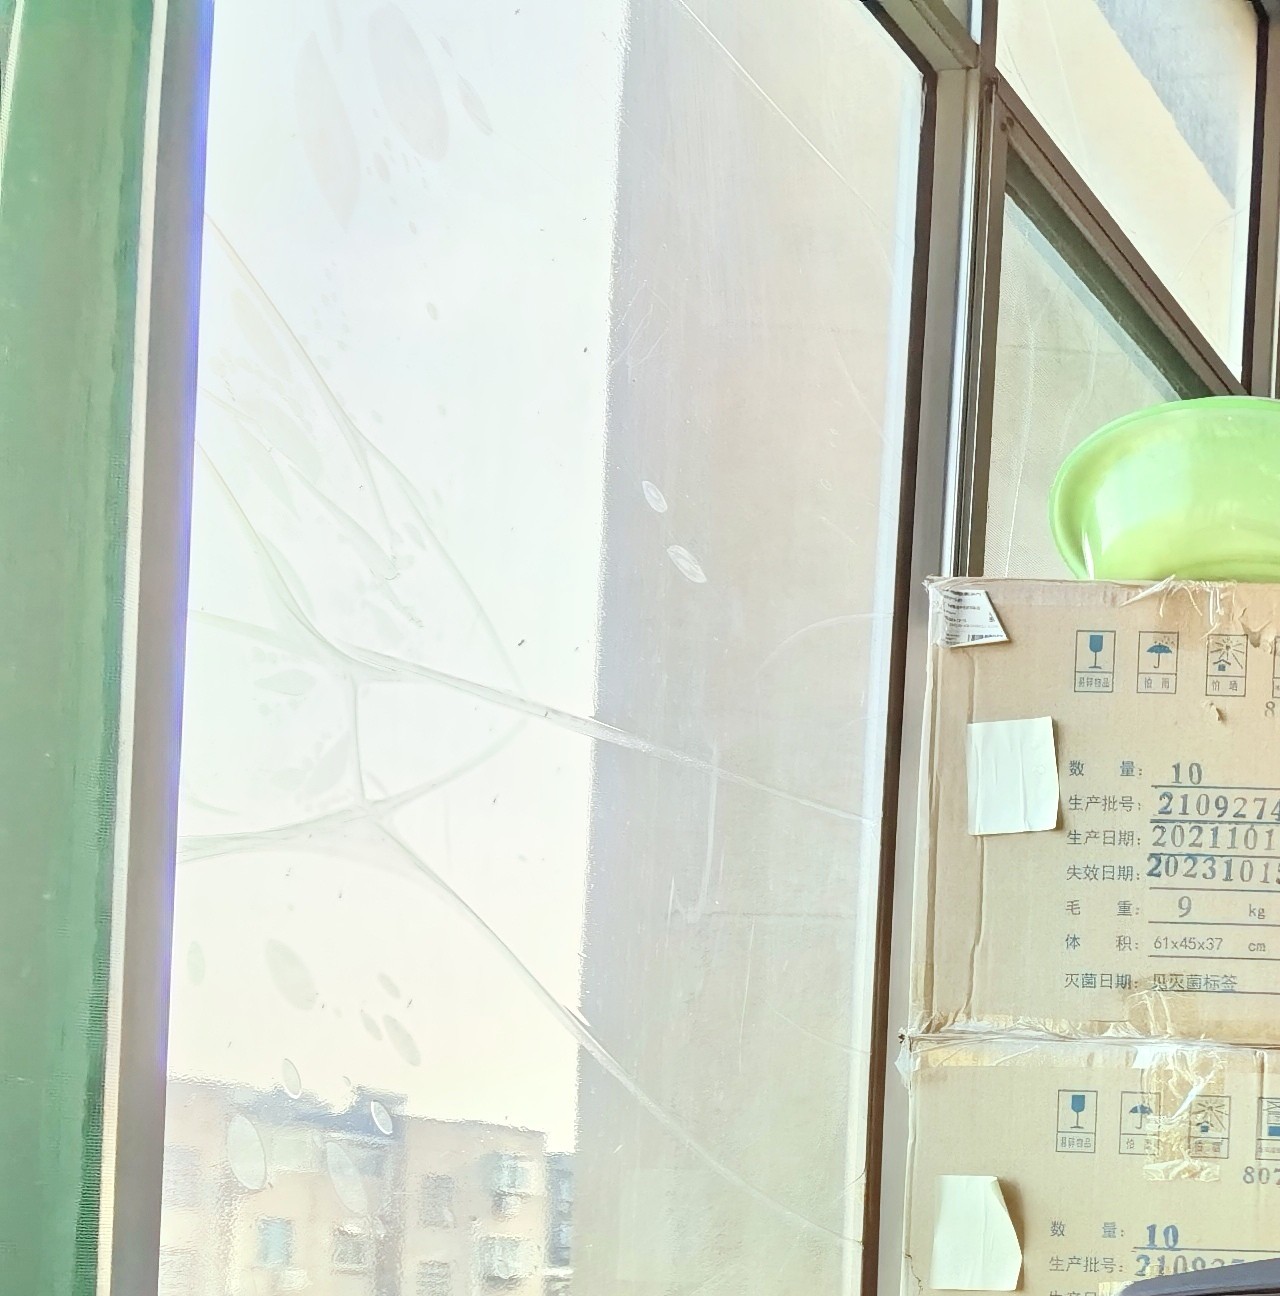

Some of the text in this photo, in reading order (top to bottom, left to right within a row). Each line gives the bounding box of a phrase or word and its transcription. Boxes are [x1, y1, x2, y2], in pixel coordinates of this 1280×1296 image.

[1171, 762, 1203, 785] 10
[1177, 895, 1192, 918] 9
[1248, 903, 1266, 919] kg
[1247, 941, 1266, 952] cm
[1146, 1223, 1180, 1250] 10
